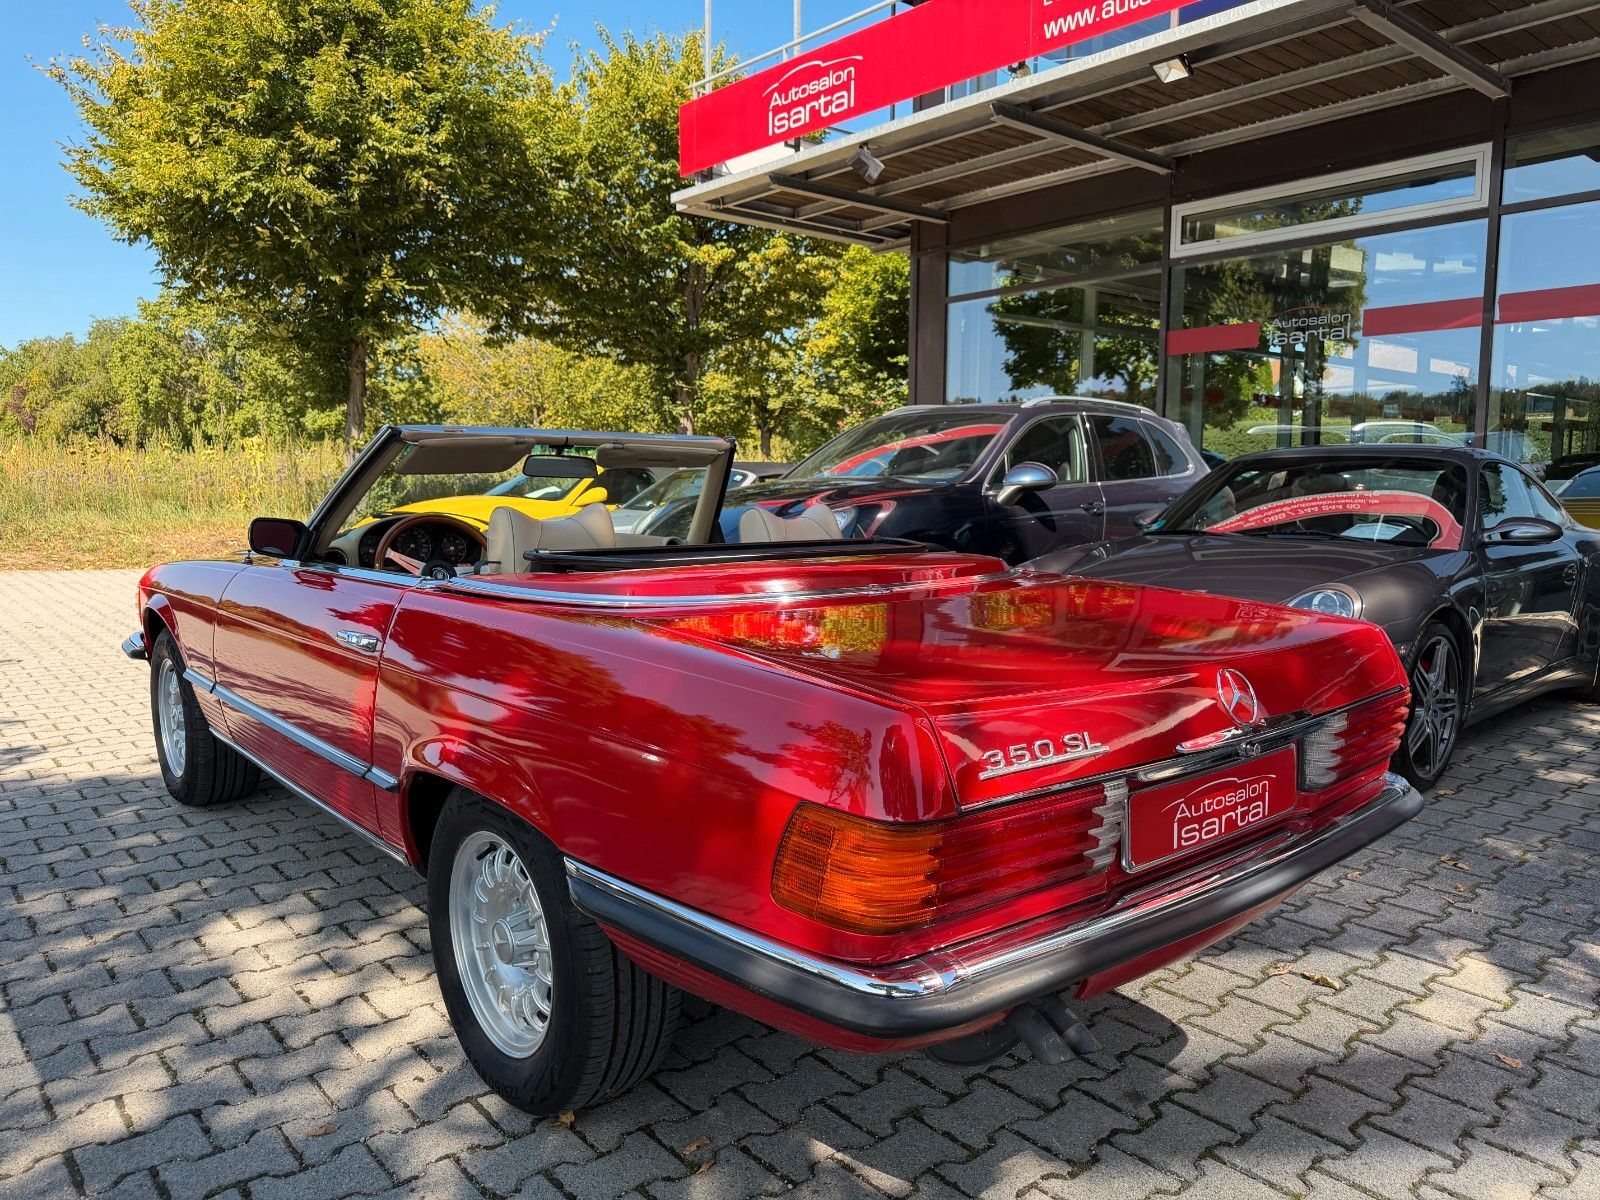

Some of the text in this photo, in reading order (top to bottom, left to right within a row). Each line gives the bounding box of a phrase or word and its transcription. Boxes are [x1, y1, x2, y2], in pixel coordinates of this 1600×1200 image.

[1043, 0, 1152, 39] www.au
[768, 79, 855, 137] Isartal
[769, 66, 855, 110] Autosalon
[1267, 320, 1351, 346] Isartal
[1272, 311, 1351, 329] Autosalon
[981, 731, 1102, 771] 350 SL
[1173, 791, 1269, 849] Isartal
[1174, 780, 1269, 822] Autosalon
